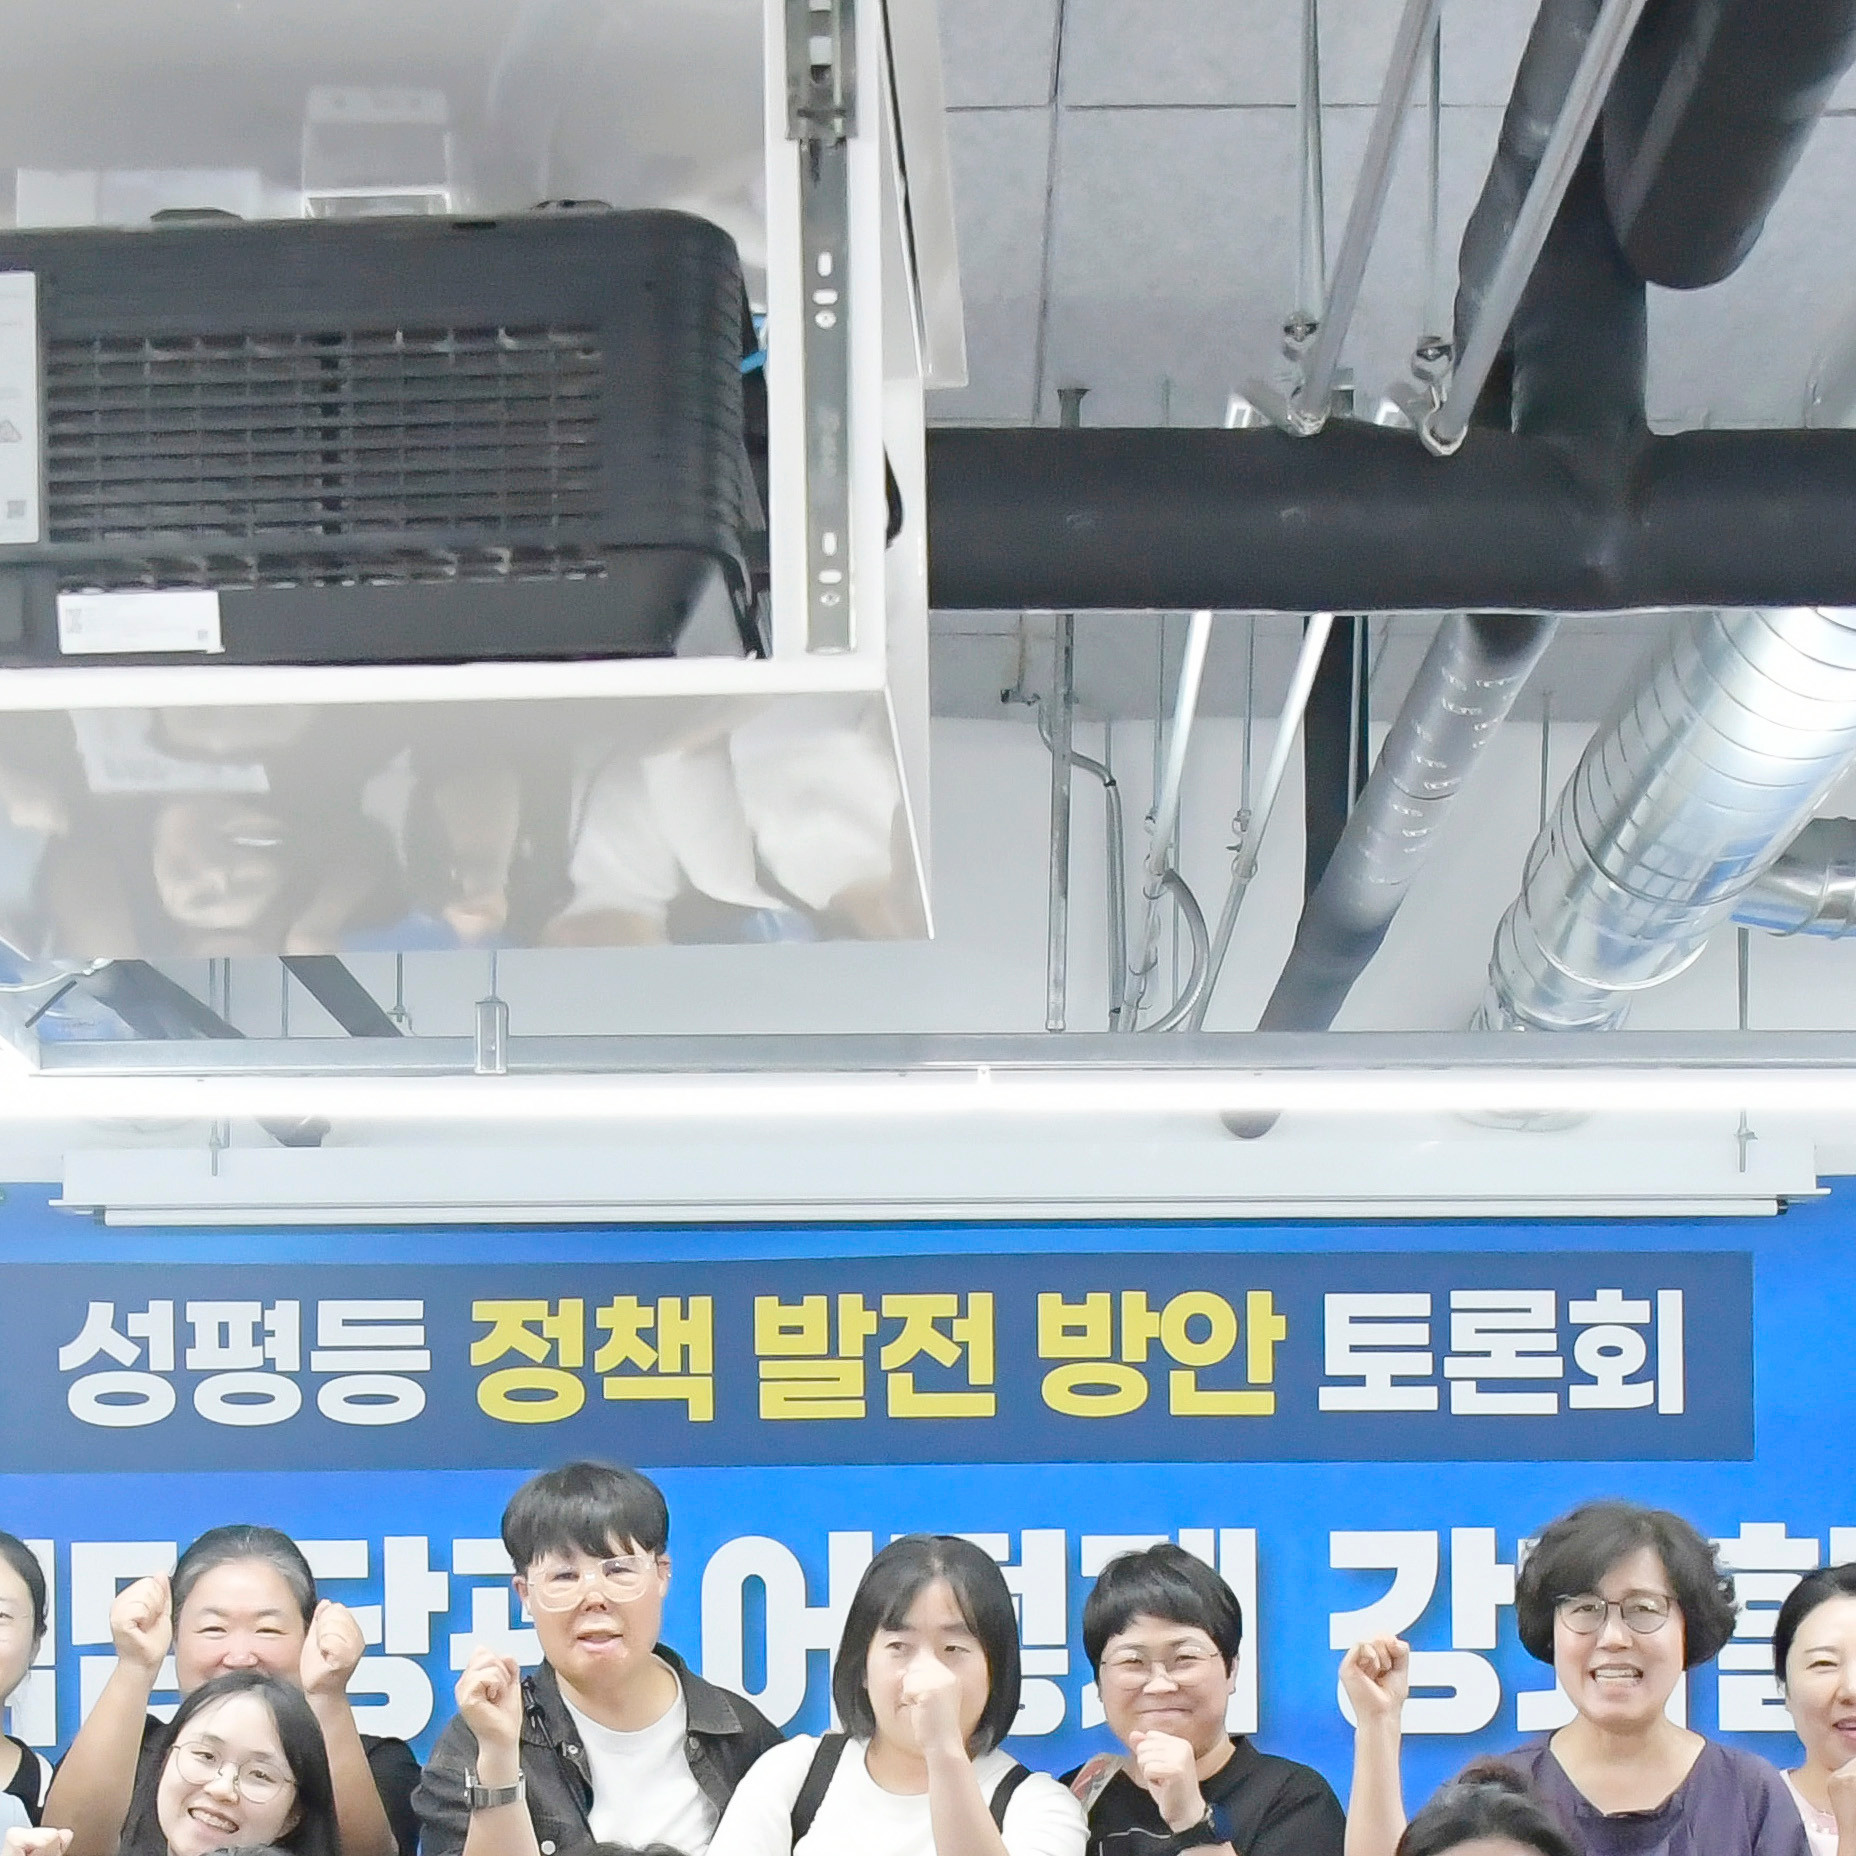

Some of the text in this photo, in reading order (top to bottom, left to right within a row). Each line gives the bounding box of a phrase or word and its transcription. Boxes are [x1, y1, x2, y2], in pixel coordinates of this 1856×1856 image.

[56, 1288, 1685, 1429] 성평등 정책 발전 방안 토론회
